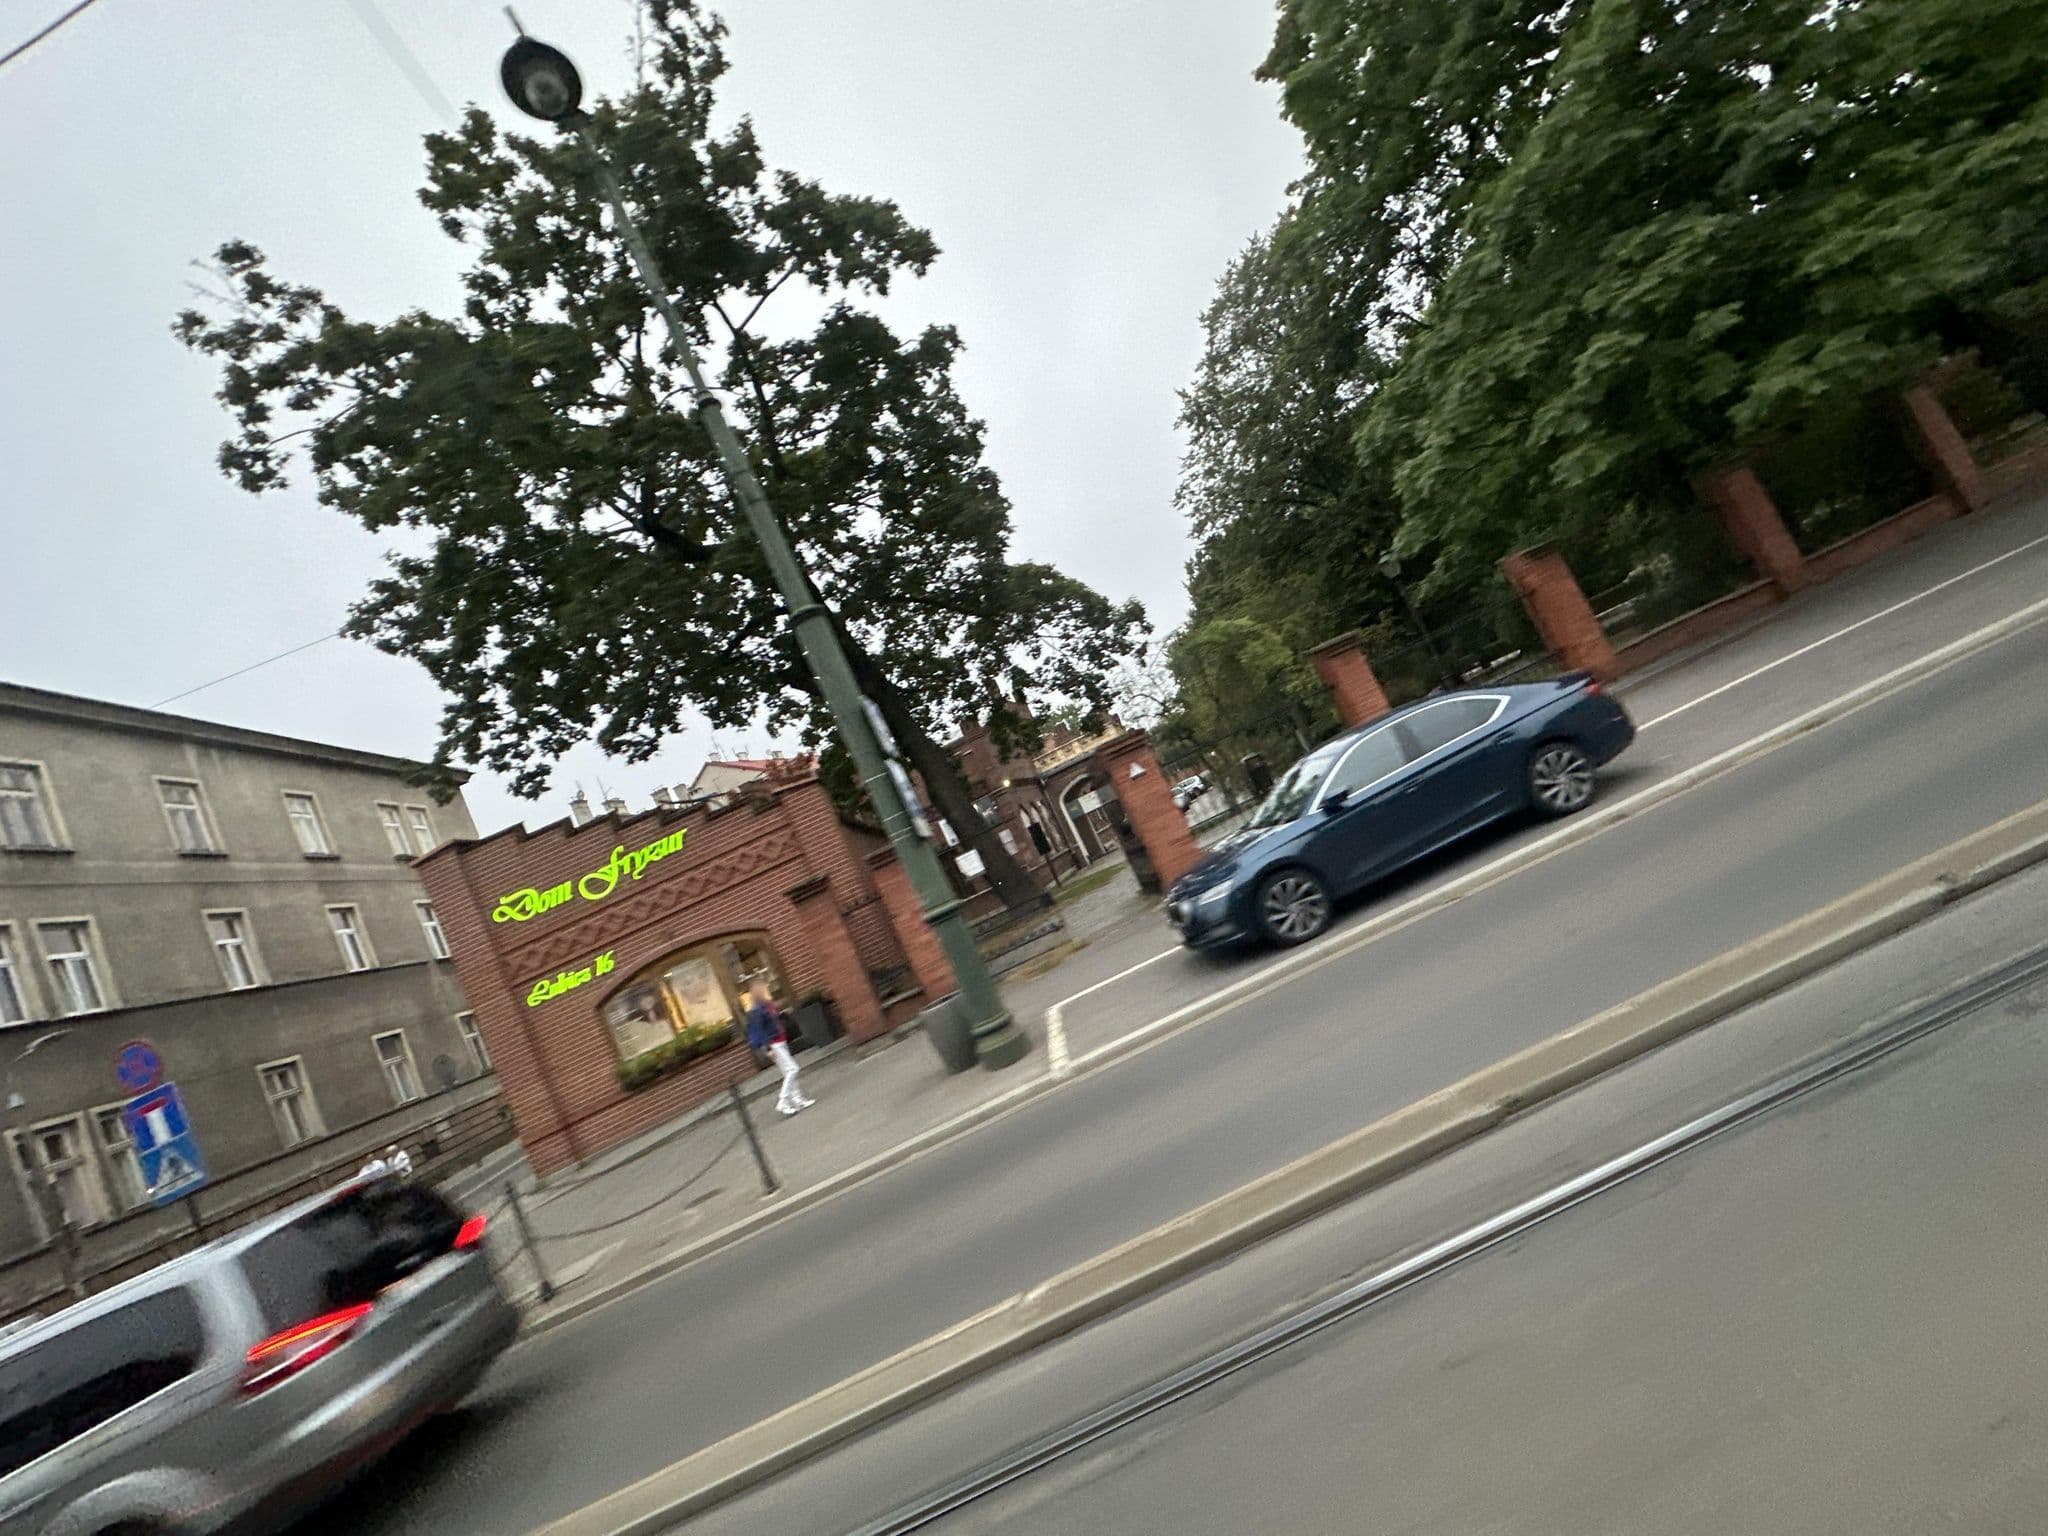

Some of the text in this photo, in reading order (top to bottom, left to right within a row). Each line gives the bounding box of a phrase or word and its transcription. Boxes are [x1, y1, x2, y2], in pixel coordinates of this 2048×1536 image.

[492, 828, 688, 923] Dom Fryzur
[594, 950, 615, 976] 16
